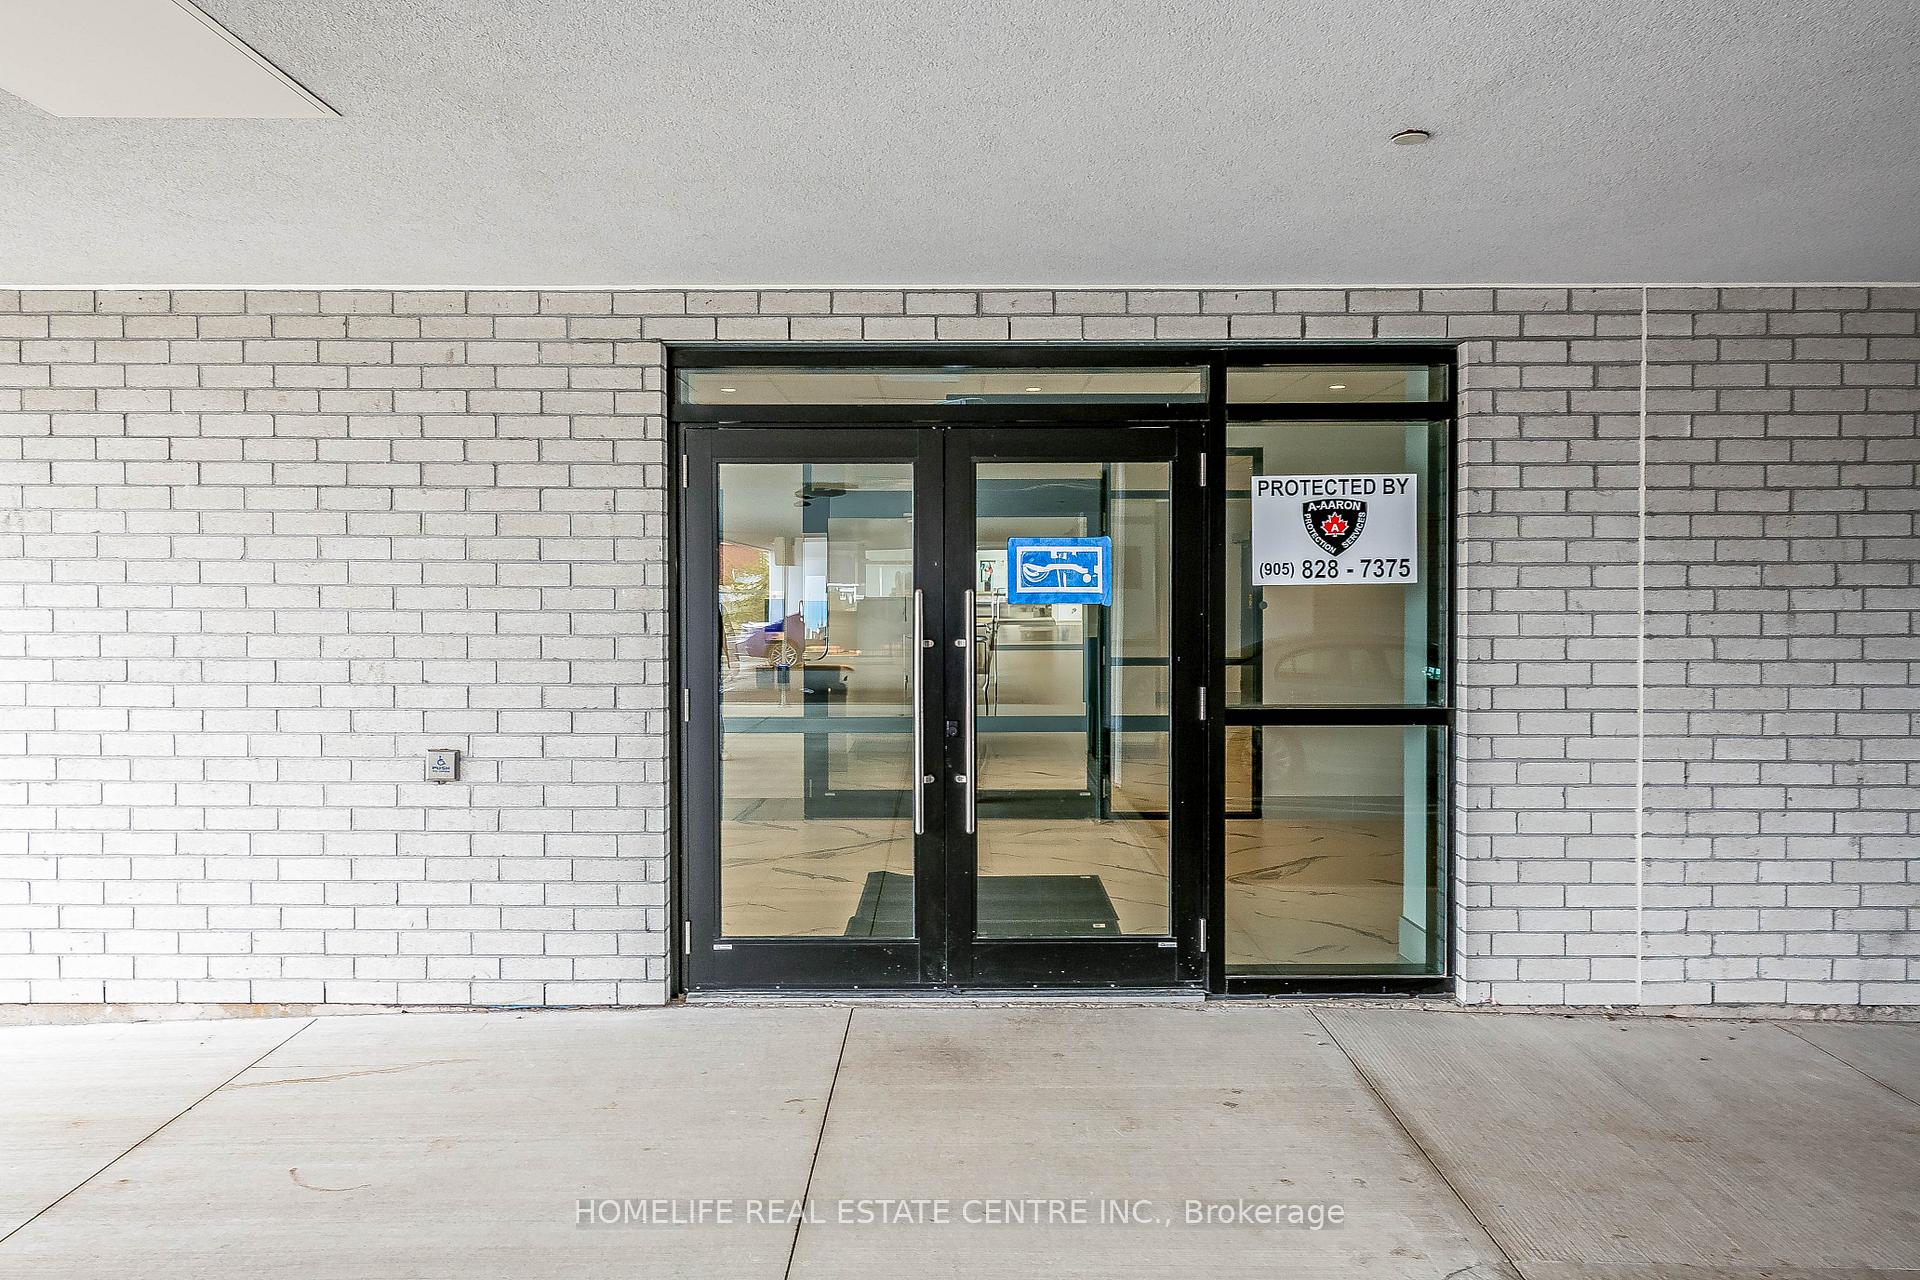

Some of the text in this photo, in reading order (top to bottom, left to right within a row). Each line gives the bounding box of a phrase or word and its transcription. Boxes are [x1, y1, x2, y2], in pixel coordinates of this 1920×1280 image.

[1258, 478, 1409, 496] PROTECTED BY
[1308, 501, 1361, 512] A-AARON
[1304, 513, 1337, 554] PROTECTION
[1331, 523, 1339, 532] A
[1341, 511, 1366, 549] SERVICES
[1259, 562, 1295, 579] (905)
[1302, 560, 1339, 579] 828
[1360, 559, 1411, 578] 7375
